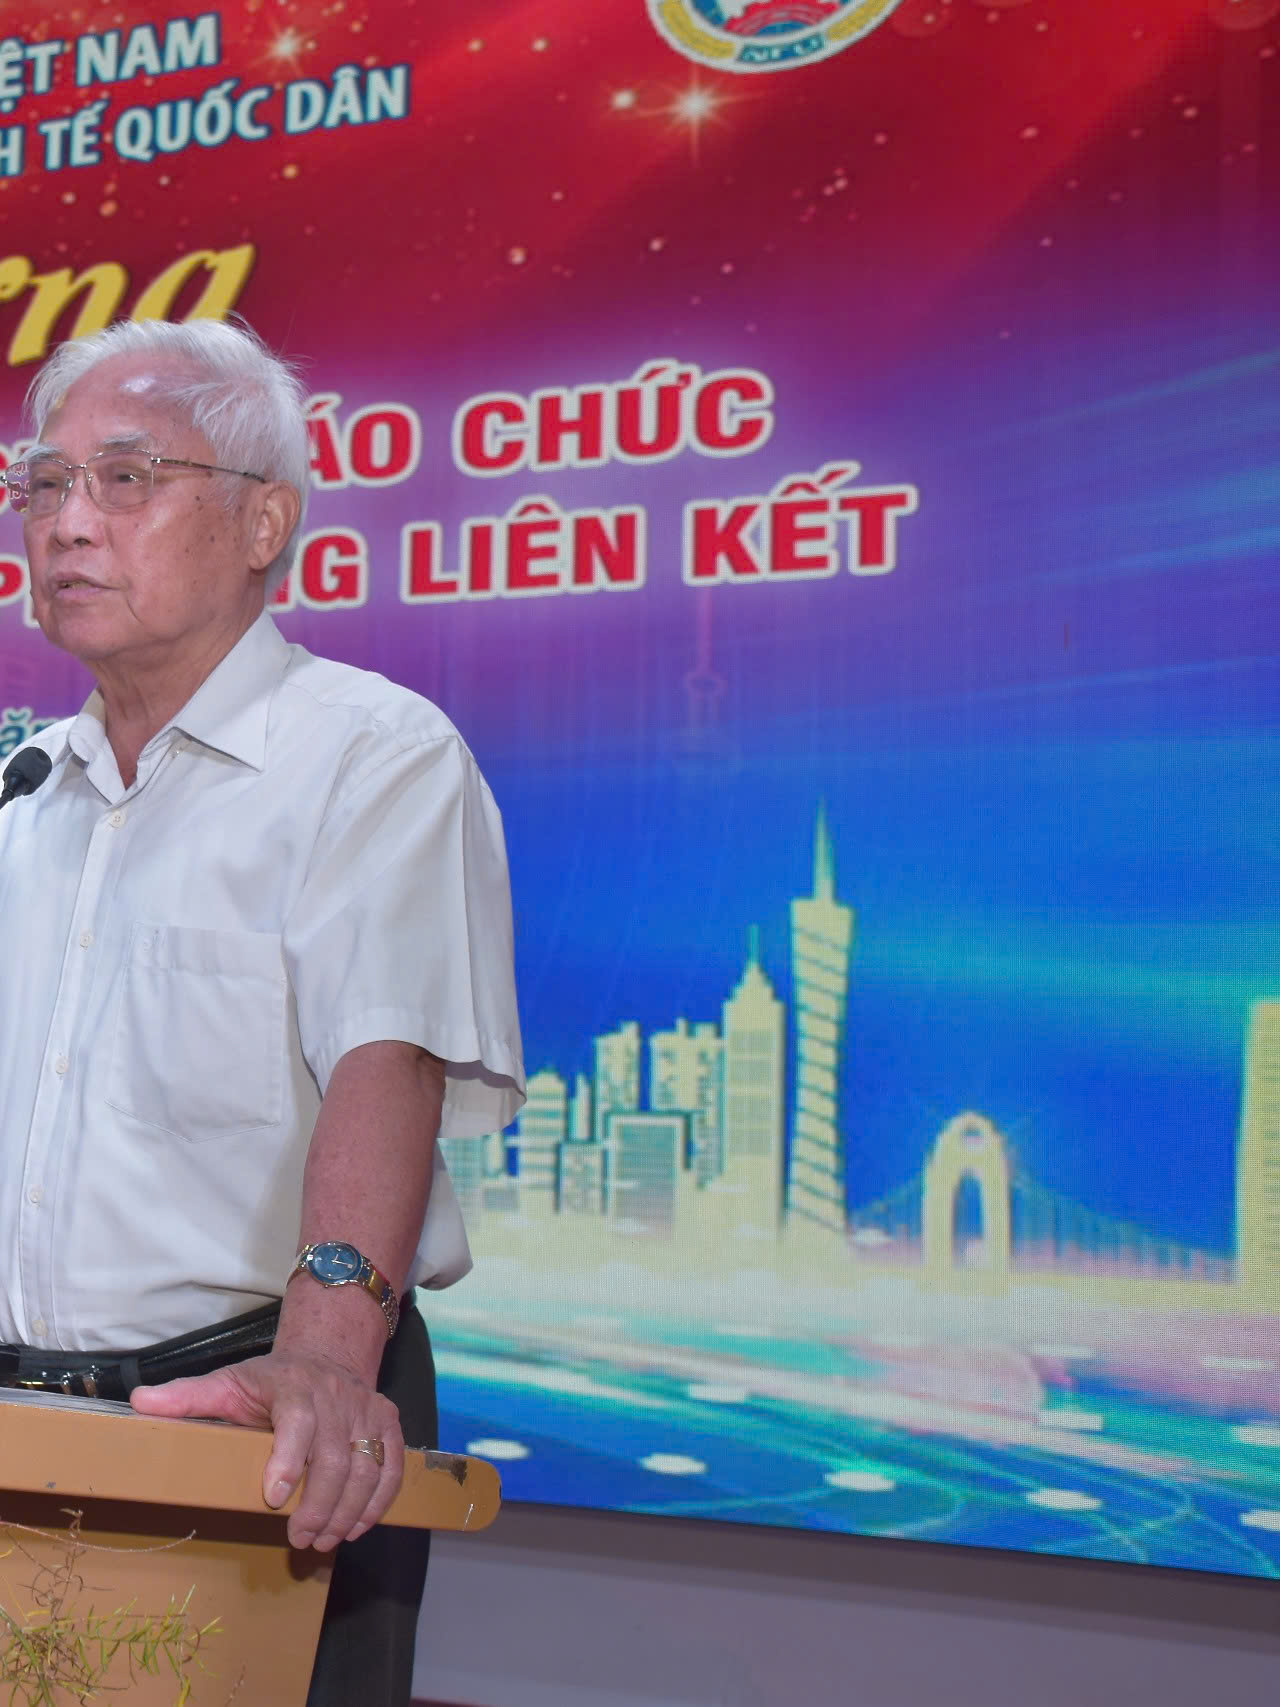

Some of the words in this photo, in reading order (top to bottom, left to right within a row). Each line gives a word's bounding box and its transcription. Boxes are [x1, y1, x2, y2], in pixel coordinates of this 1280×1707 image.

[75, 15, 220, 84] NAM
[40, 101, 109, 171] TẾ
[116, 76, 269, 162] QUỐC
[285, 65, 410, 134] DÂN
[459, 366, 768, 472] CHỨC
[409, 502, 637, 597] LIÊN
[690, 468, 910, 578] KẾT
